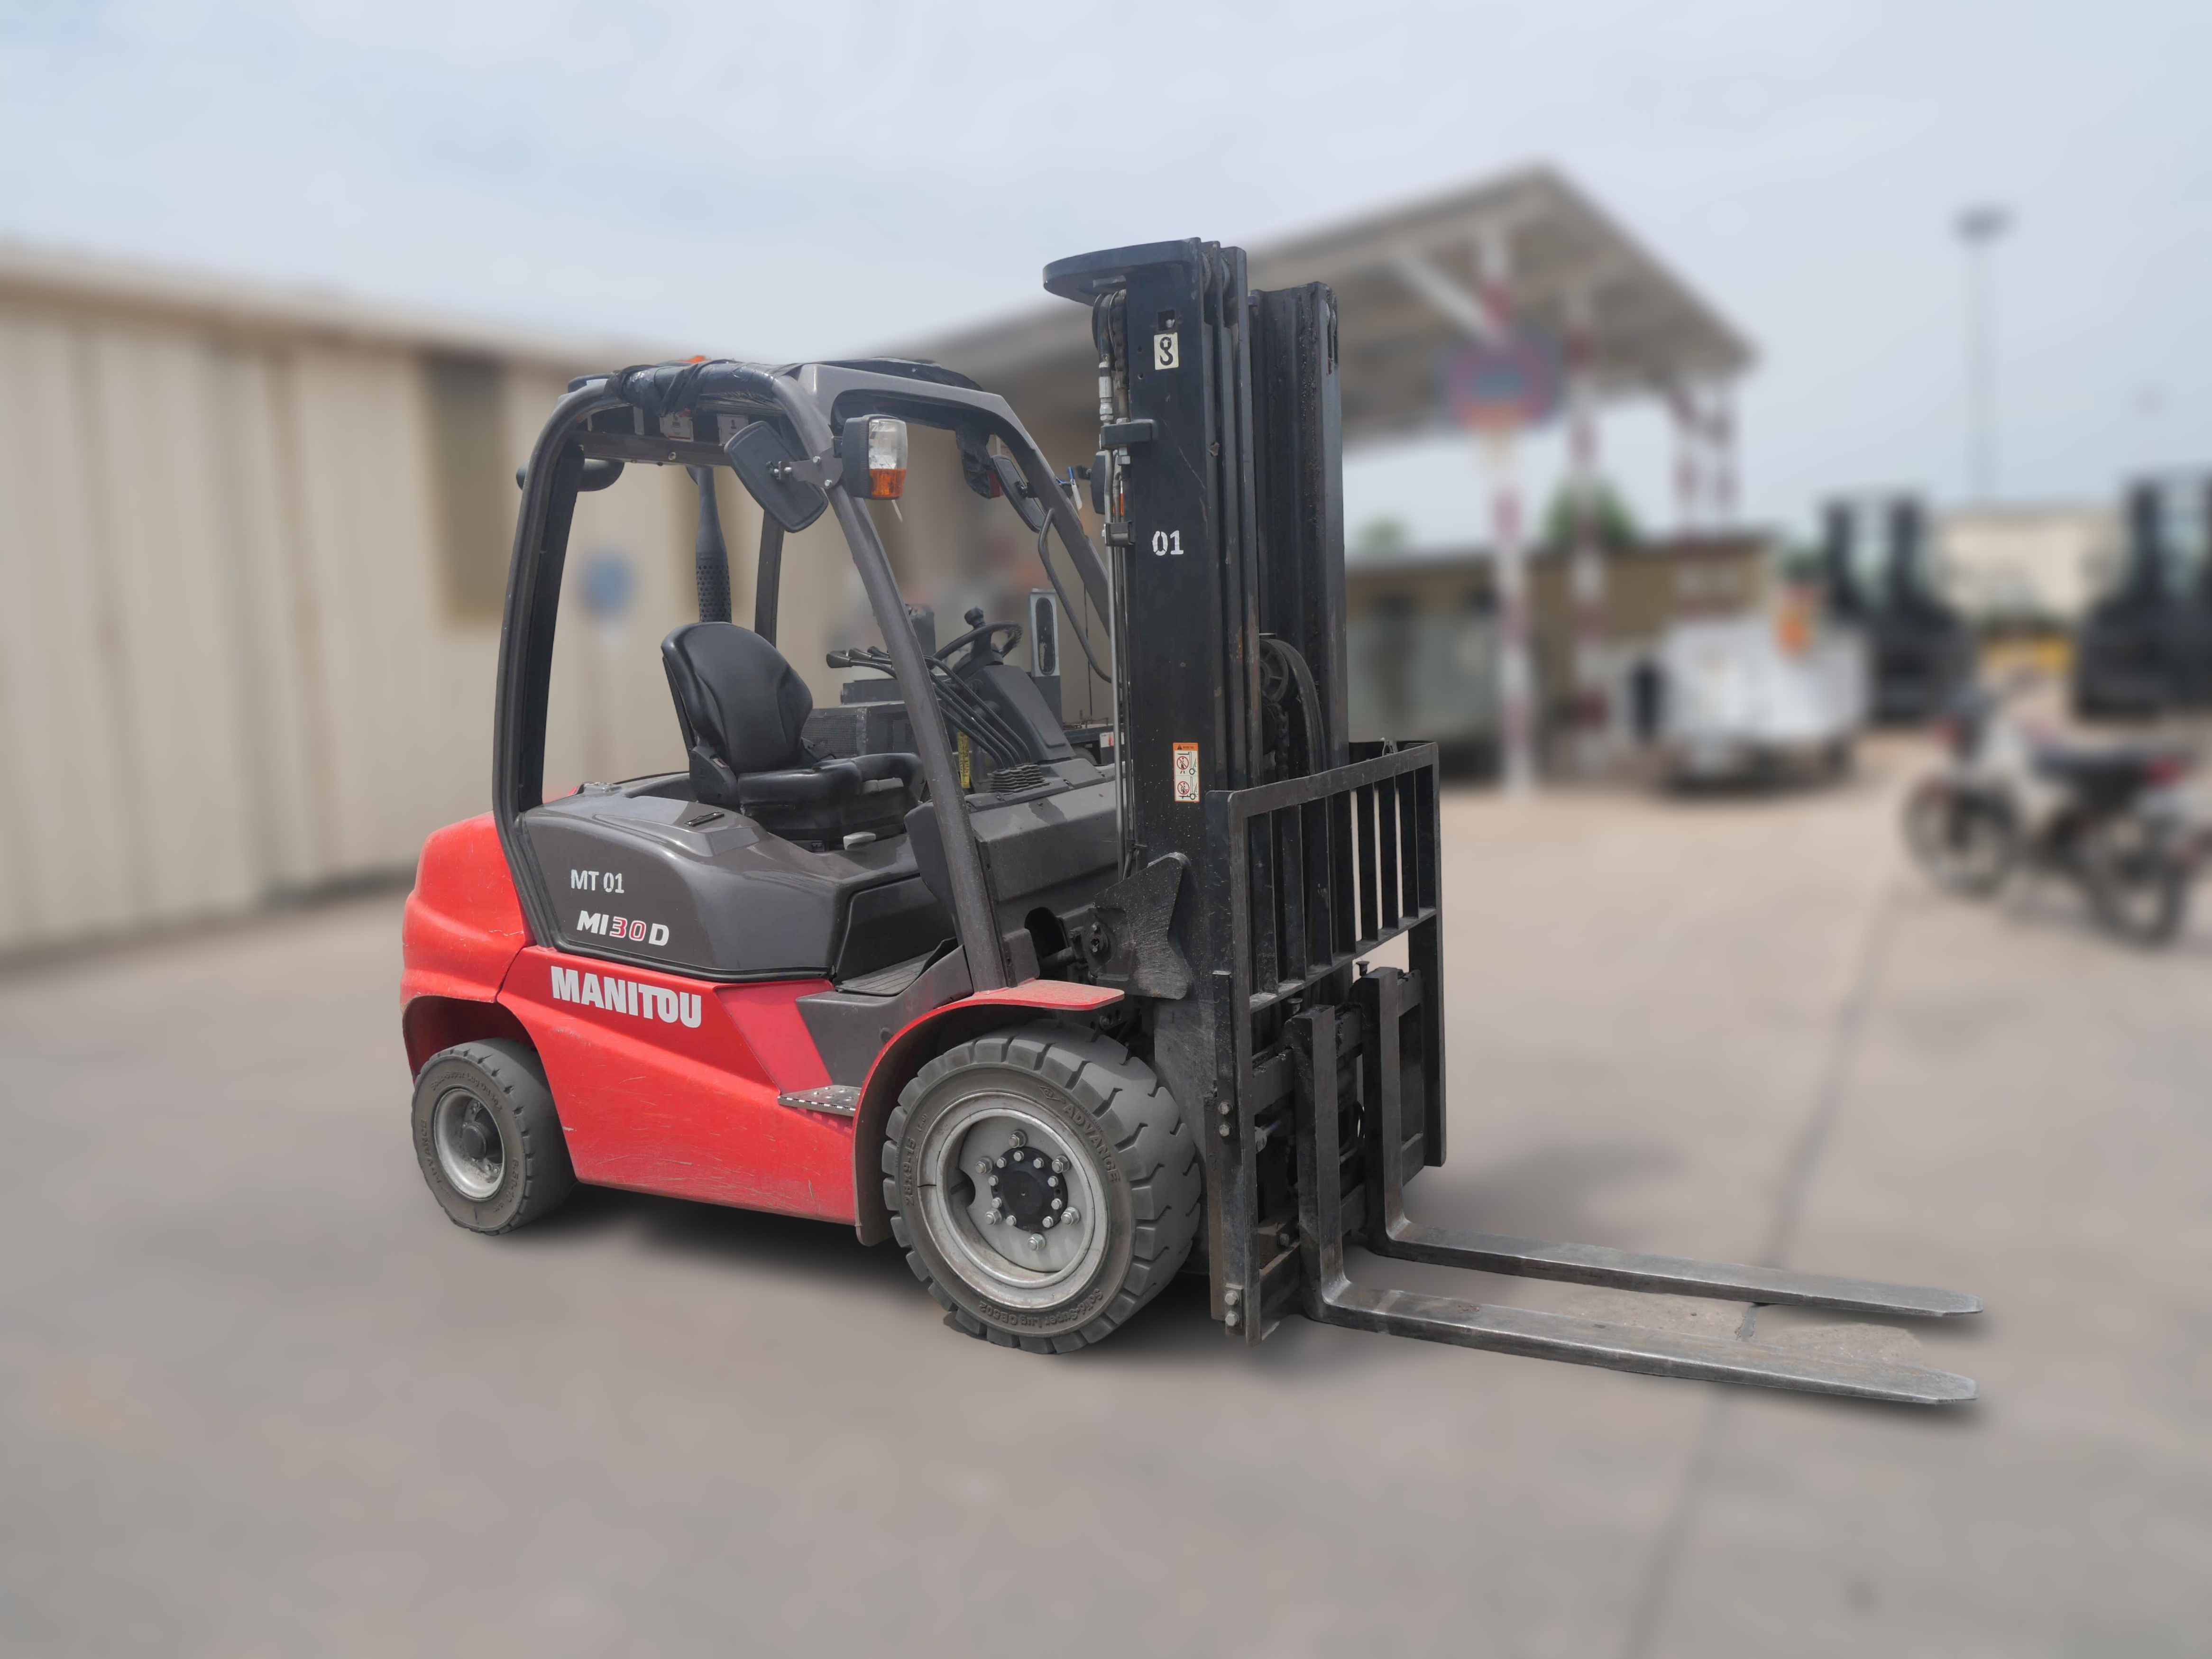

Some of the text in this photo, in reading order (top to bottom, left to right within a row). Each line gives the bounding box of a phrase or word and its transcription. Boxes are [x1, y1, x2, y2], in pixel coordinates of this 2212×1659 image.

[1152, 530, 1184, 556] 01
[571, 870, 624, 893] MT 01
[551, 966, 702, 1028] MANITOU
[1063, 1104, 1121, 1182] ADVANCE
